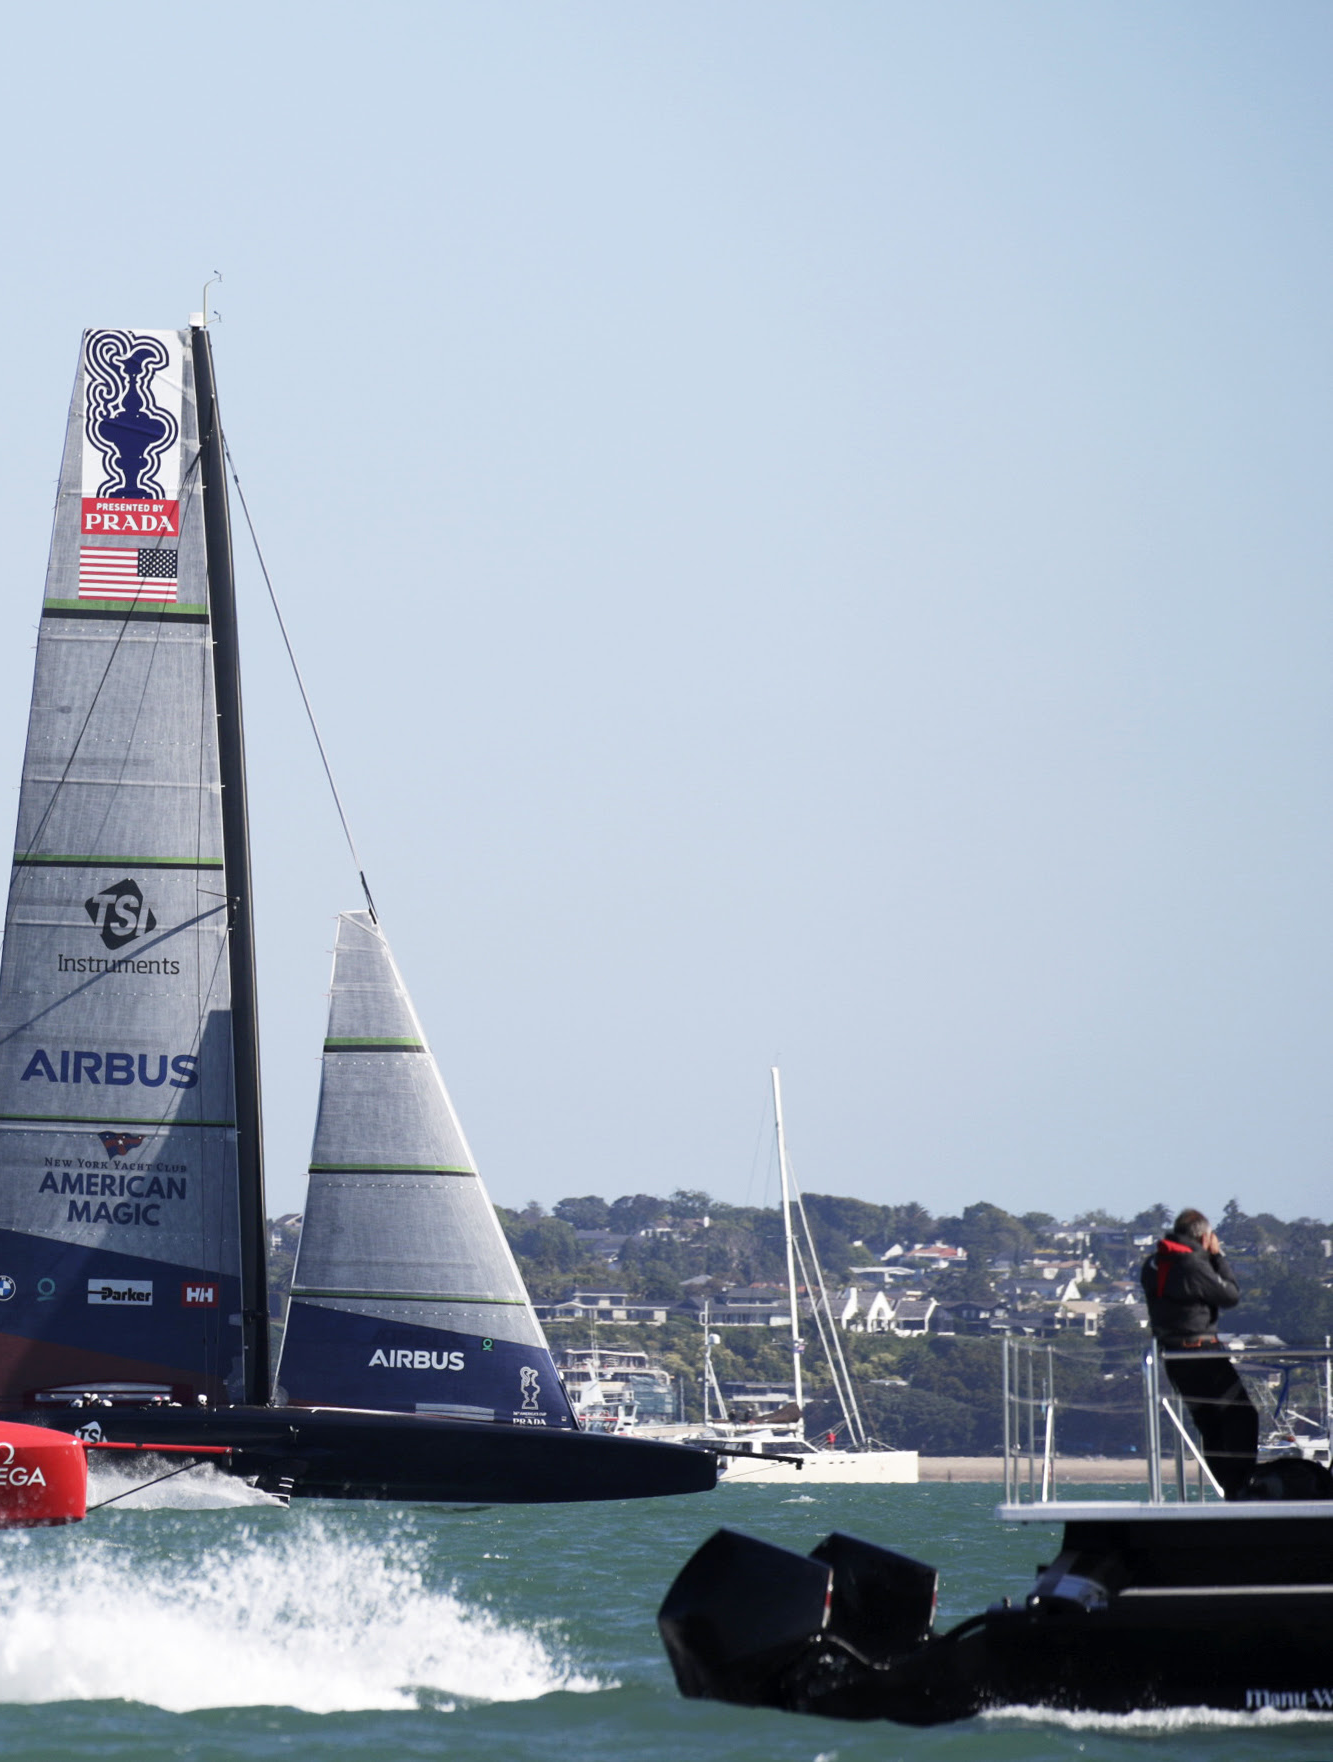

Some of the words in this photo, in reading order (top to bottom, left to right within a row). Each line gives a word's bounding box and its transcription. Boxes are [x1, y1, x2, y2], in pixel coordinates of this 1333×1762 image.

[96, 502, 150, 512] PRESENTED
[152, 503, 164, 512] BY
[85, 513, 174, 532] PRADA
[92, 894, 150, 937] TSI
[58, 954, 180, 975] Instruments
[20, 1049, 199, 1090] AIRBUS
[38, 1171, 186, 1200] AMERICAN
[67, 1200, 161, 1227] MAGIC
[101, 1287, 151, 1302] Parker
[368, 1349, 465, 1371] AIRBUS
[513, 1418, 546, 1426] PRADA
